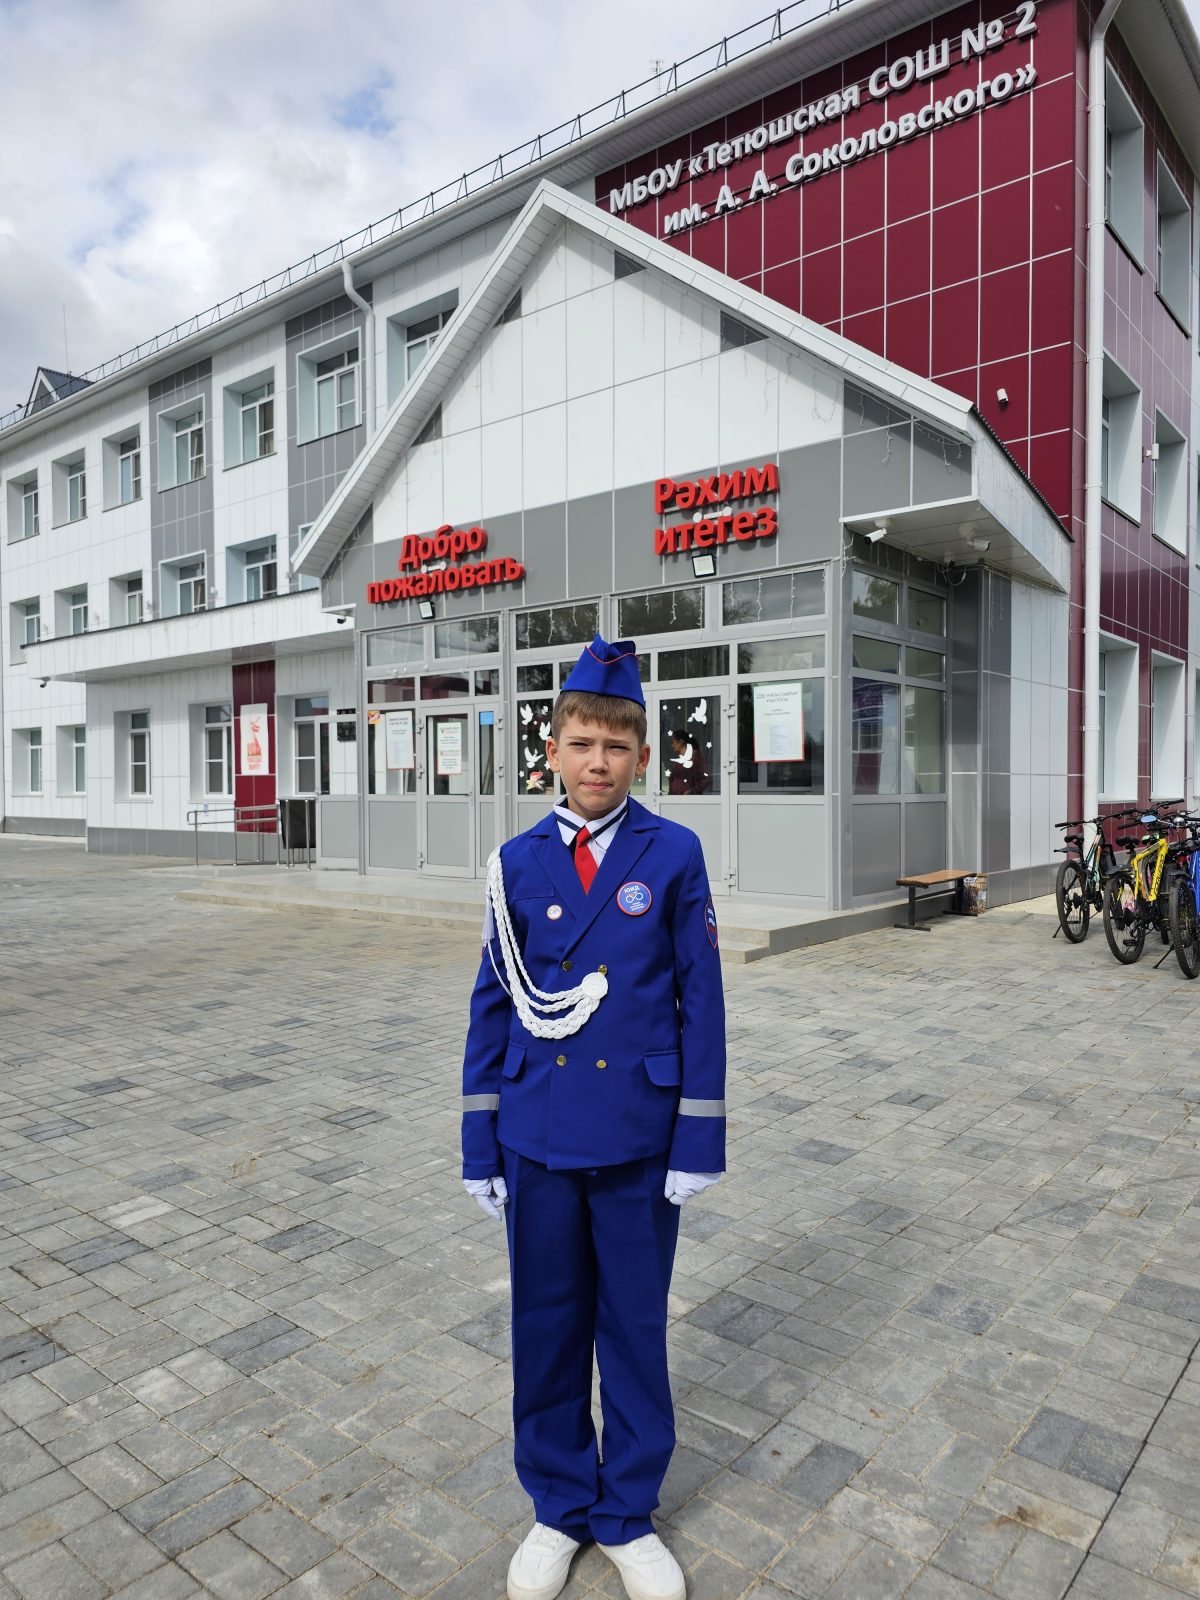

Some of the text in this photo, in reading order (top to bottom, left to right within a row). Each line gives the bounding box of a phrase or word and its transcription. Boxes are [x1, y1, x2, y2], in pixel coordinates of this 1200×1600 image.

[609, 0, 1039, 214] МБОУ «Тетюшская СОШ № 2
[664, 63, 1039, 235] им. А. А. Соколовского»
[654, 463, 779, 515] Рәхим
[398, 524, 487, 571] Добро
[654, 506, 778, 556] итегез
[367, 557, 525, 605] пожаловать
